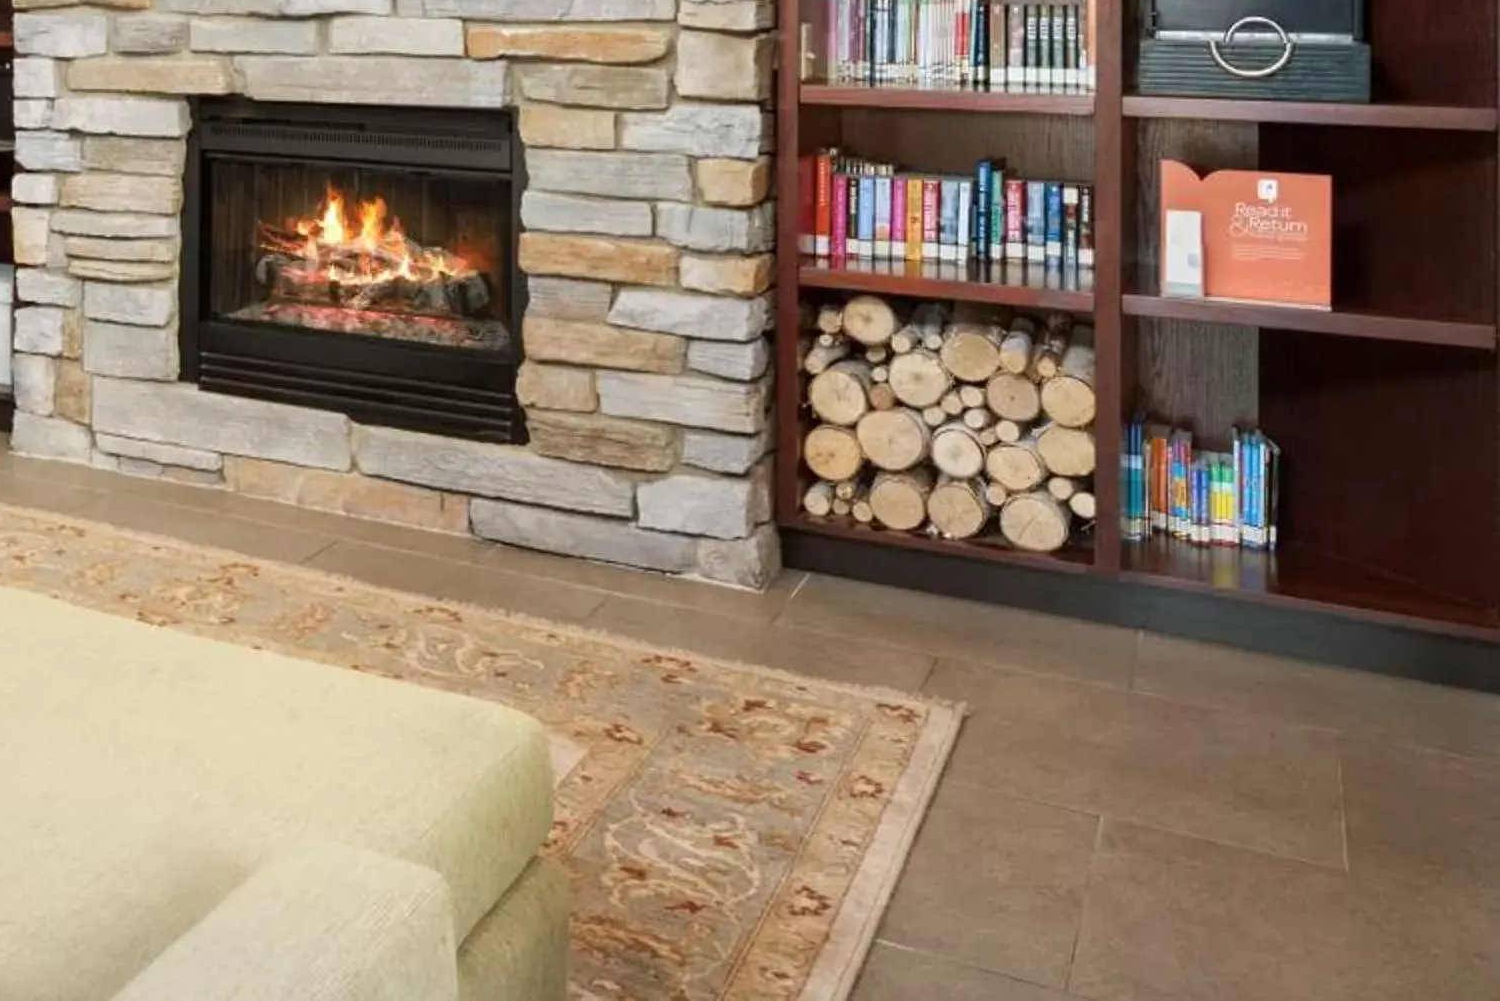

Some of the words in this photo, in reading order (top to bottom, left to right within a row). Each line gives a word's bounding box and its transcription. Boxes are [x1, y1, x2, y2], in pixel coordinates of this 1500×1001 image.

[1235, 202, 1278, 218] Read
[1280, 206, 1292, 218] it
[1249, 217, 1307, 233] Return
